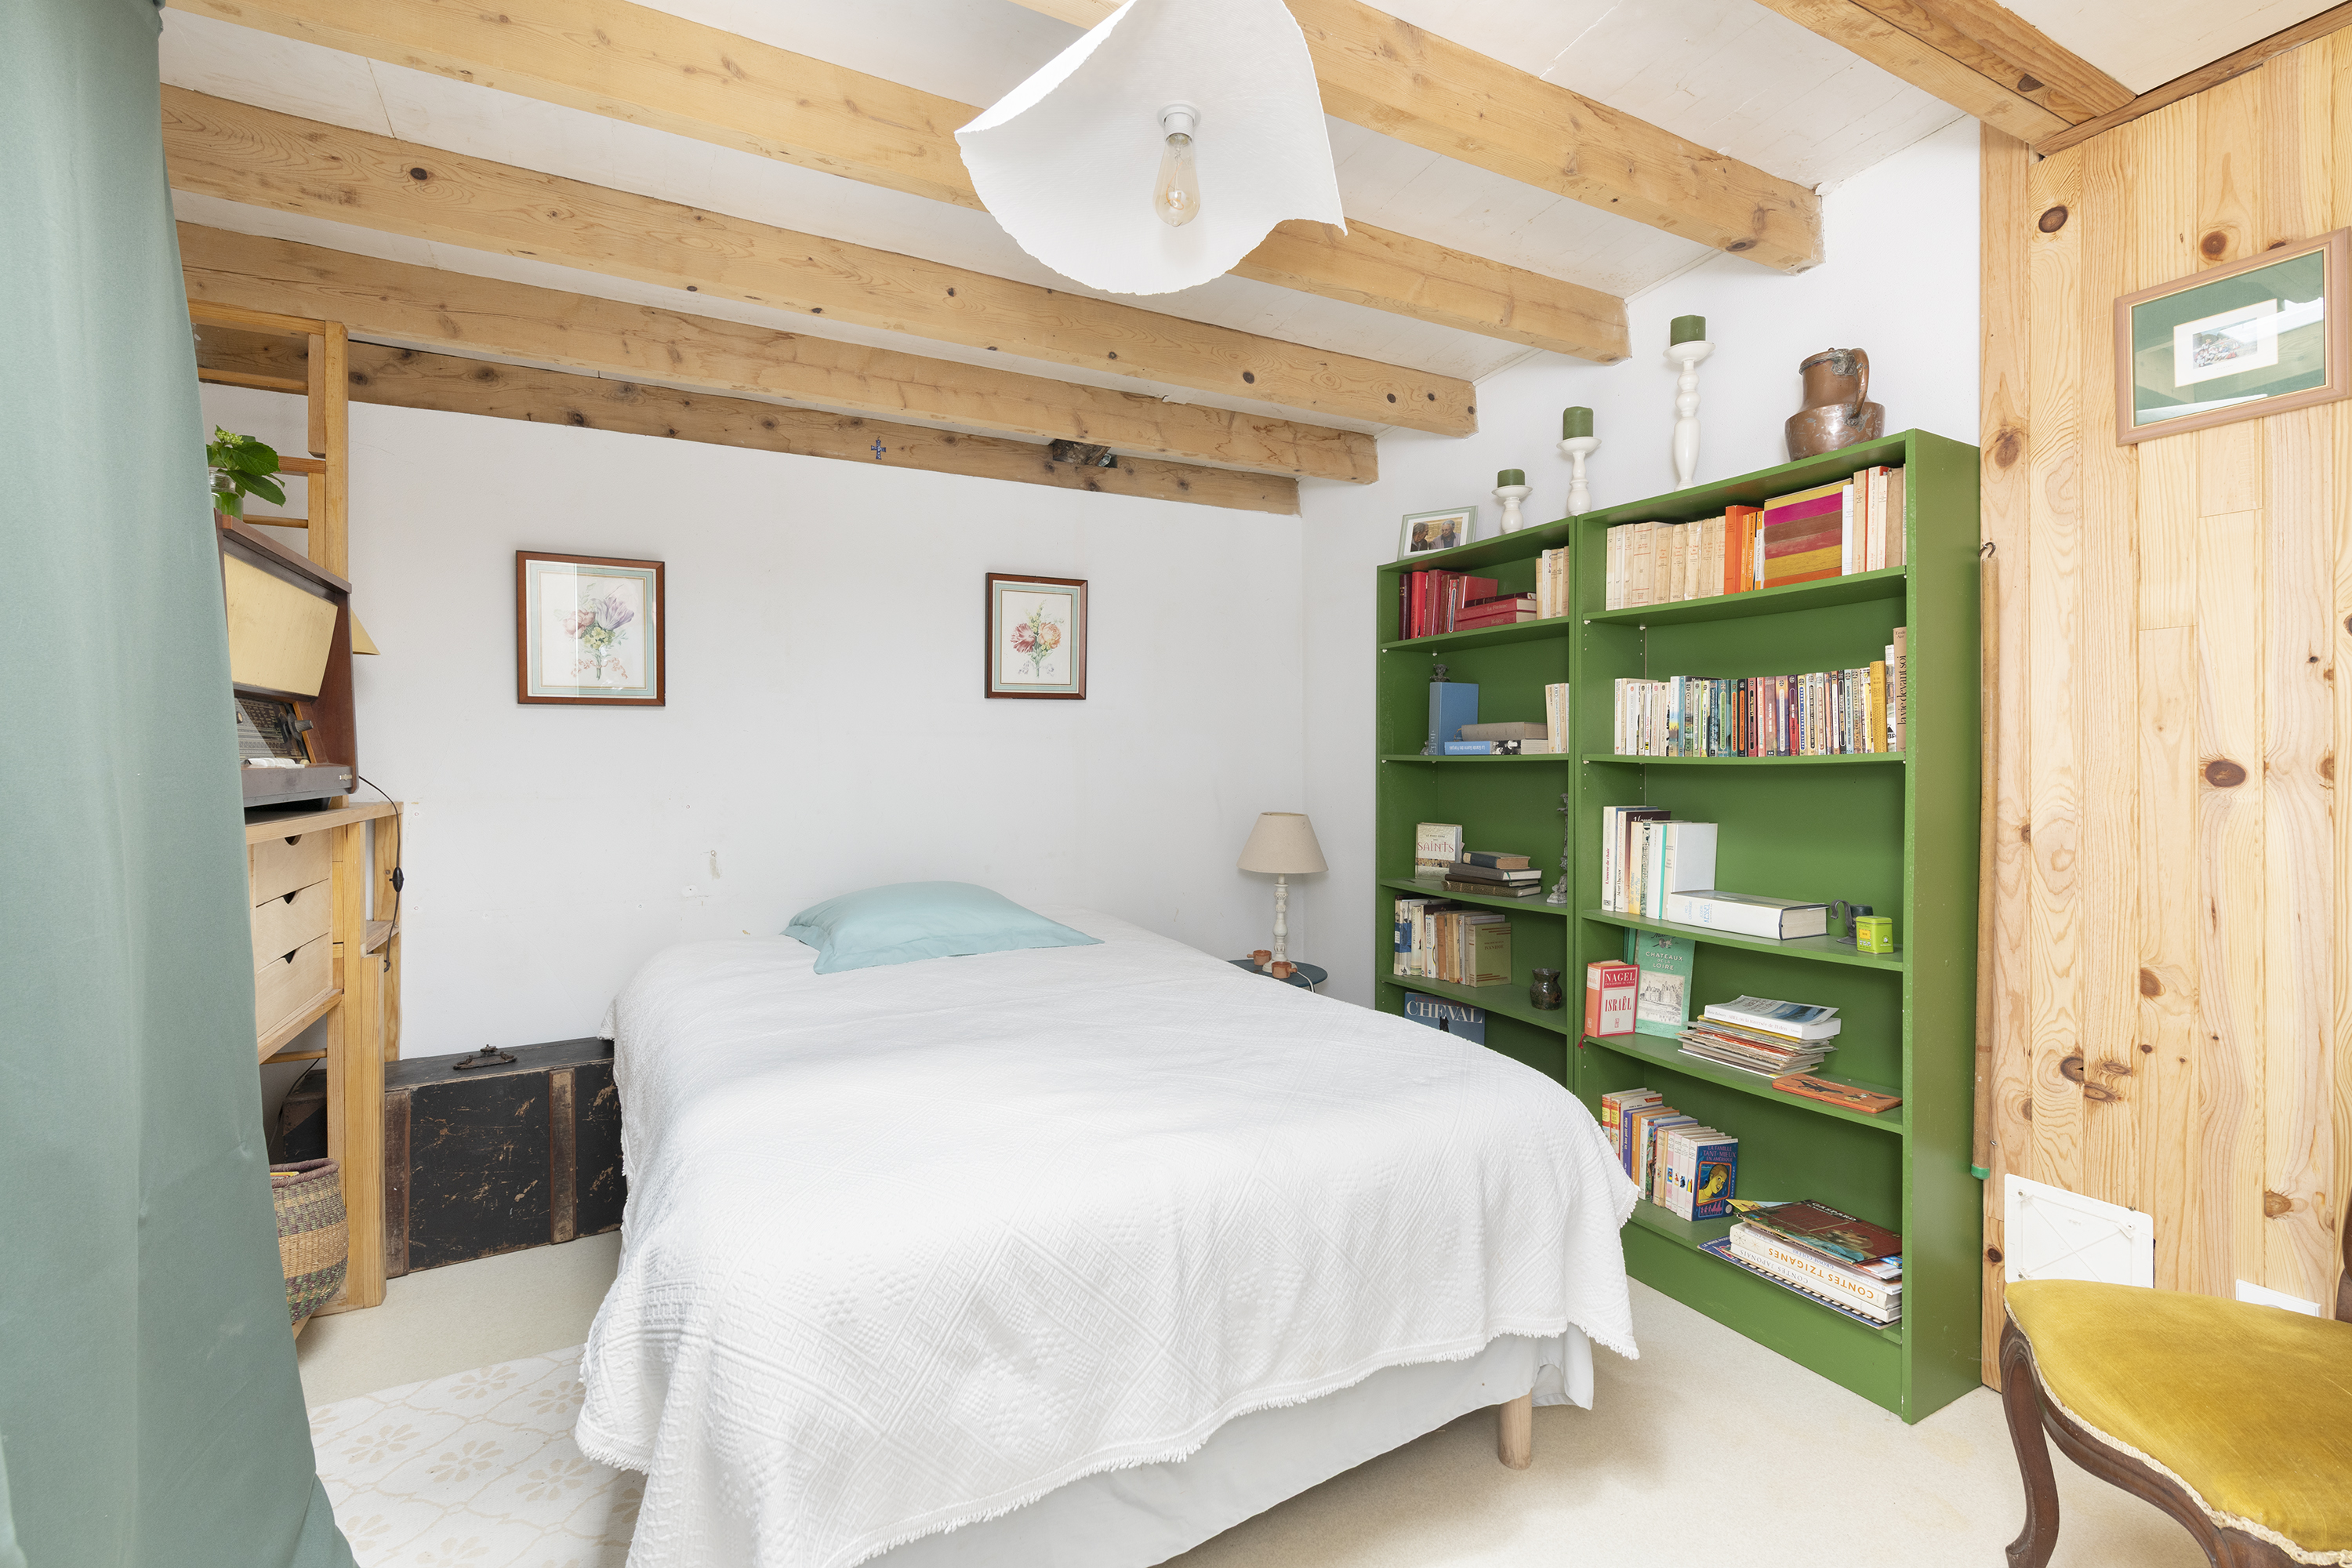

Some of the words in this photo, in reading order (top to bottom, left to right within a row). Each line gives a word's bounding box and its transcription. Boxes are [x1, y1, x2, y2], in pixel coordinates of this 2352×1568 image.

[1896, 655, 1906, 669] soi
[1896, 669, 1906, 702] devant
[1898, 702, 1906, 715] vie
[1417, 841, 1454, 853] SAINTS
[1645, 951, 1684, 961] CHATEAUX
[1605, 972, 1635, 983] NAGEL
[1406, 1000, 1482, 1023] CHEVAL
[1605, 996, 1632, 1012] ISRAËL
[1812, 1203, 1856, 1221] GASPARD
[1740, 1249, 1774, 1271] JAPONAIS
[1768, 1248, 1824, 1278] TZIGANES
[1813, 1257, 1834, 1269] GROSSE
[1777, 1266, 1808, 1284] CONTES
[1828, 1273, 1874, 1299] CONTES
